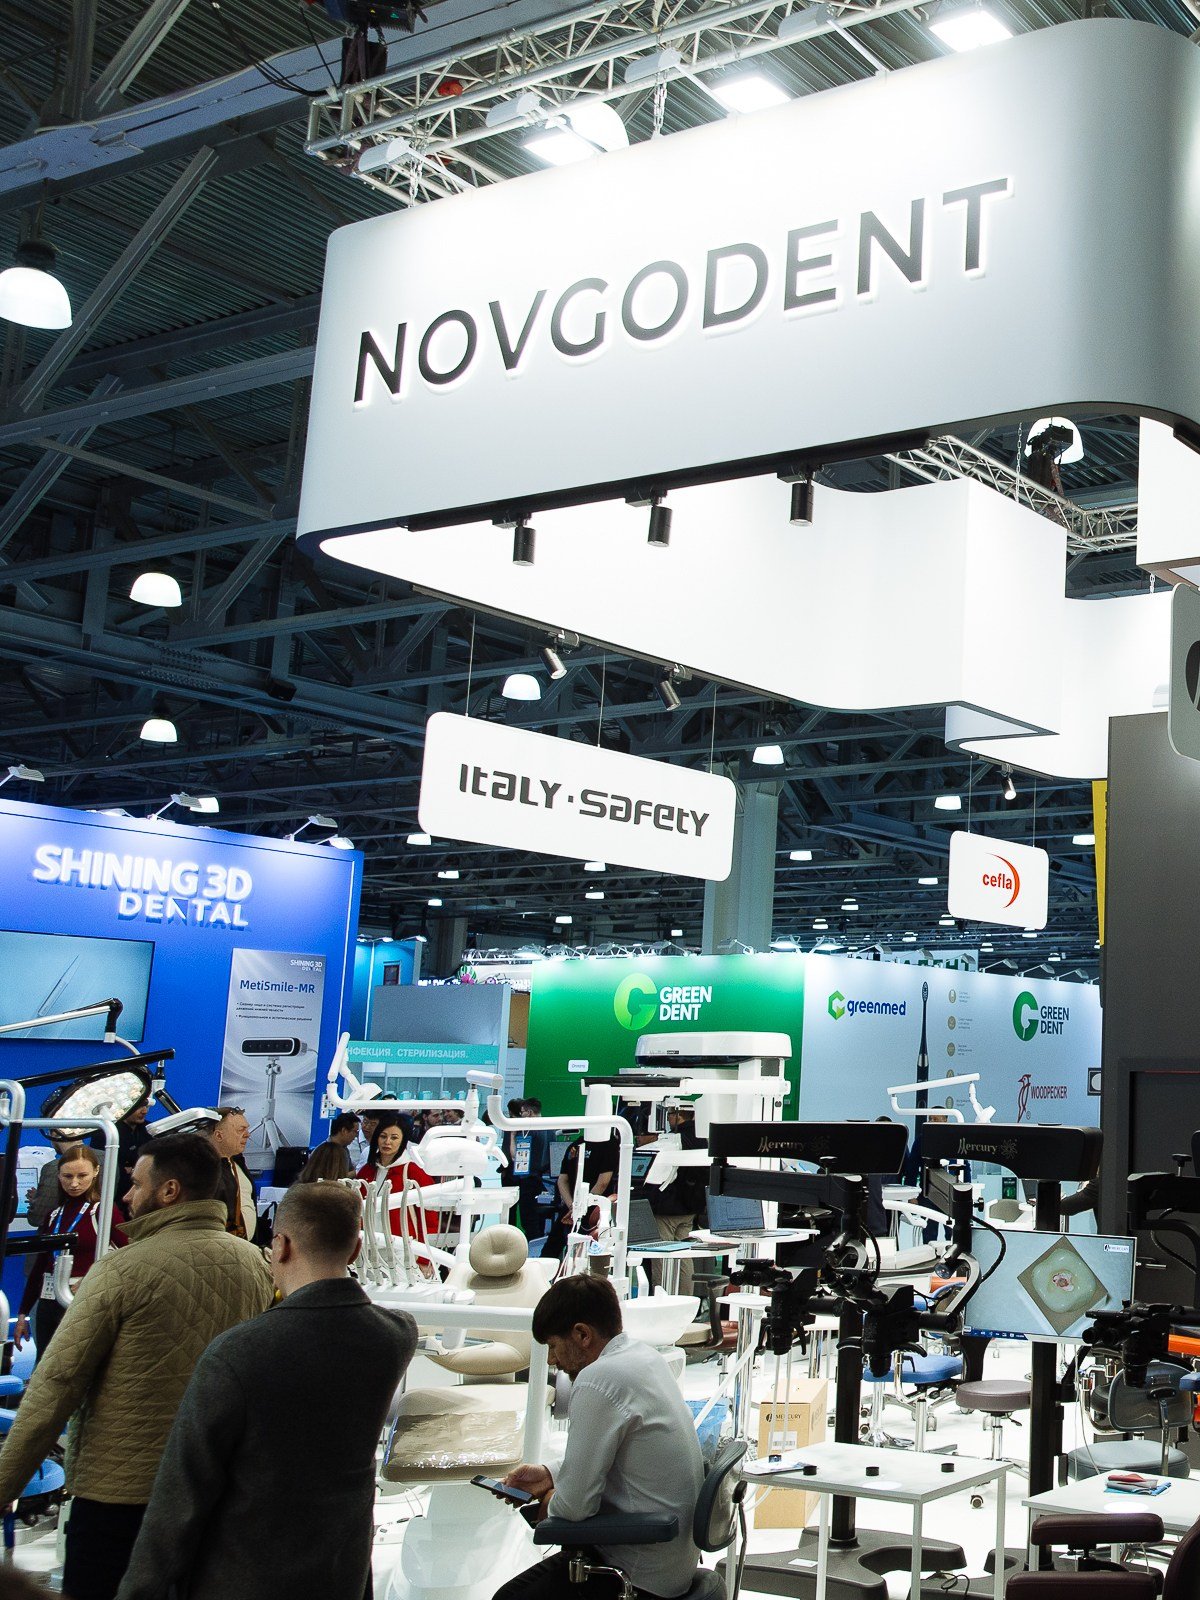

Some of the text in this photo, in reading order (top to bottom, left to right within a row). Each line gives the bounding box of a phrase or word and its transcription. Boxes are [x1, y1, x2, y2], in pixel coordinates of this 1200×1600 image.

[353, 177, 1009, 403] NOVGODENT
[33, 844, 253, 901] SHINING 3D
[982, 873, 1013, 890] cefla
[119, 892, 249, 927] DENTAL
[290, 959, 315, 968] SHINING
[239, 979, 315, 993] MetiSmile-MR
[659, 985, 713, 1004] GREEN
[659, 1003, 702, 1021] DENT
[846, 999, 907, 1017] greenmed
[1040, 1005, 1070, 1021] GREEN
[1040, 1021, 1064, 1035] DENT
[347, 1047, 469, 1059] НФЕКЦИЯ. СТЕРИЛИЗАЦИЯ.
[1030, 1085, 1068, 1099] WOODPECKER
[757, 1136, 806, 1152] Mercury
[957, 1137, 998, 1155] Mercury
